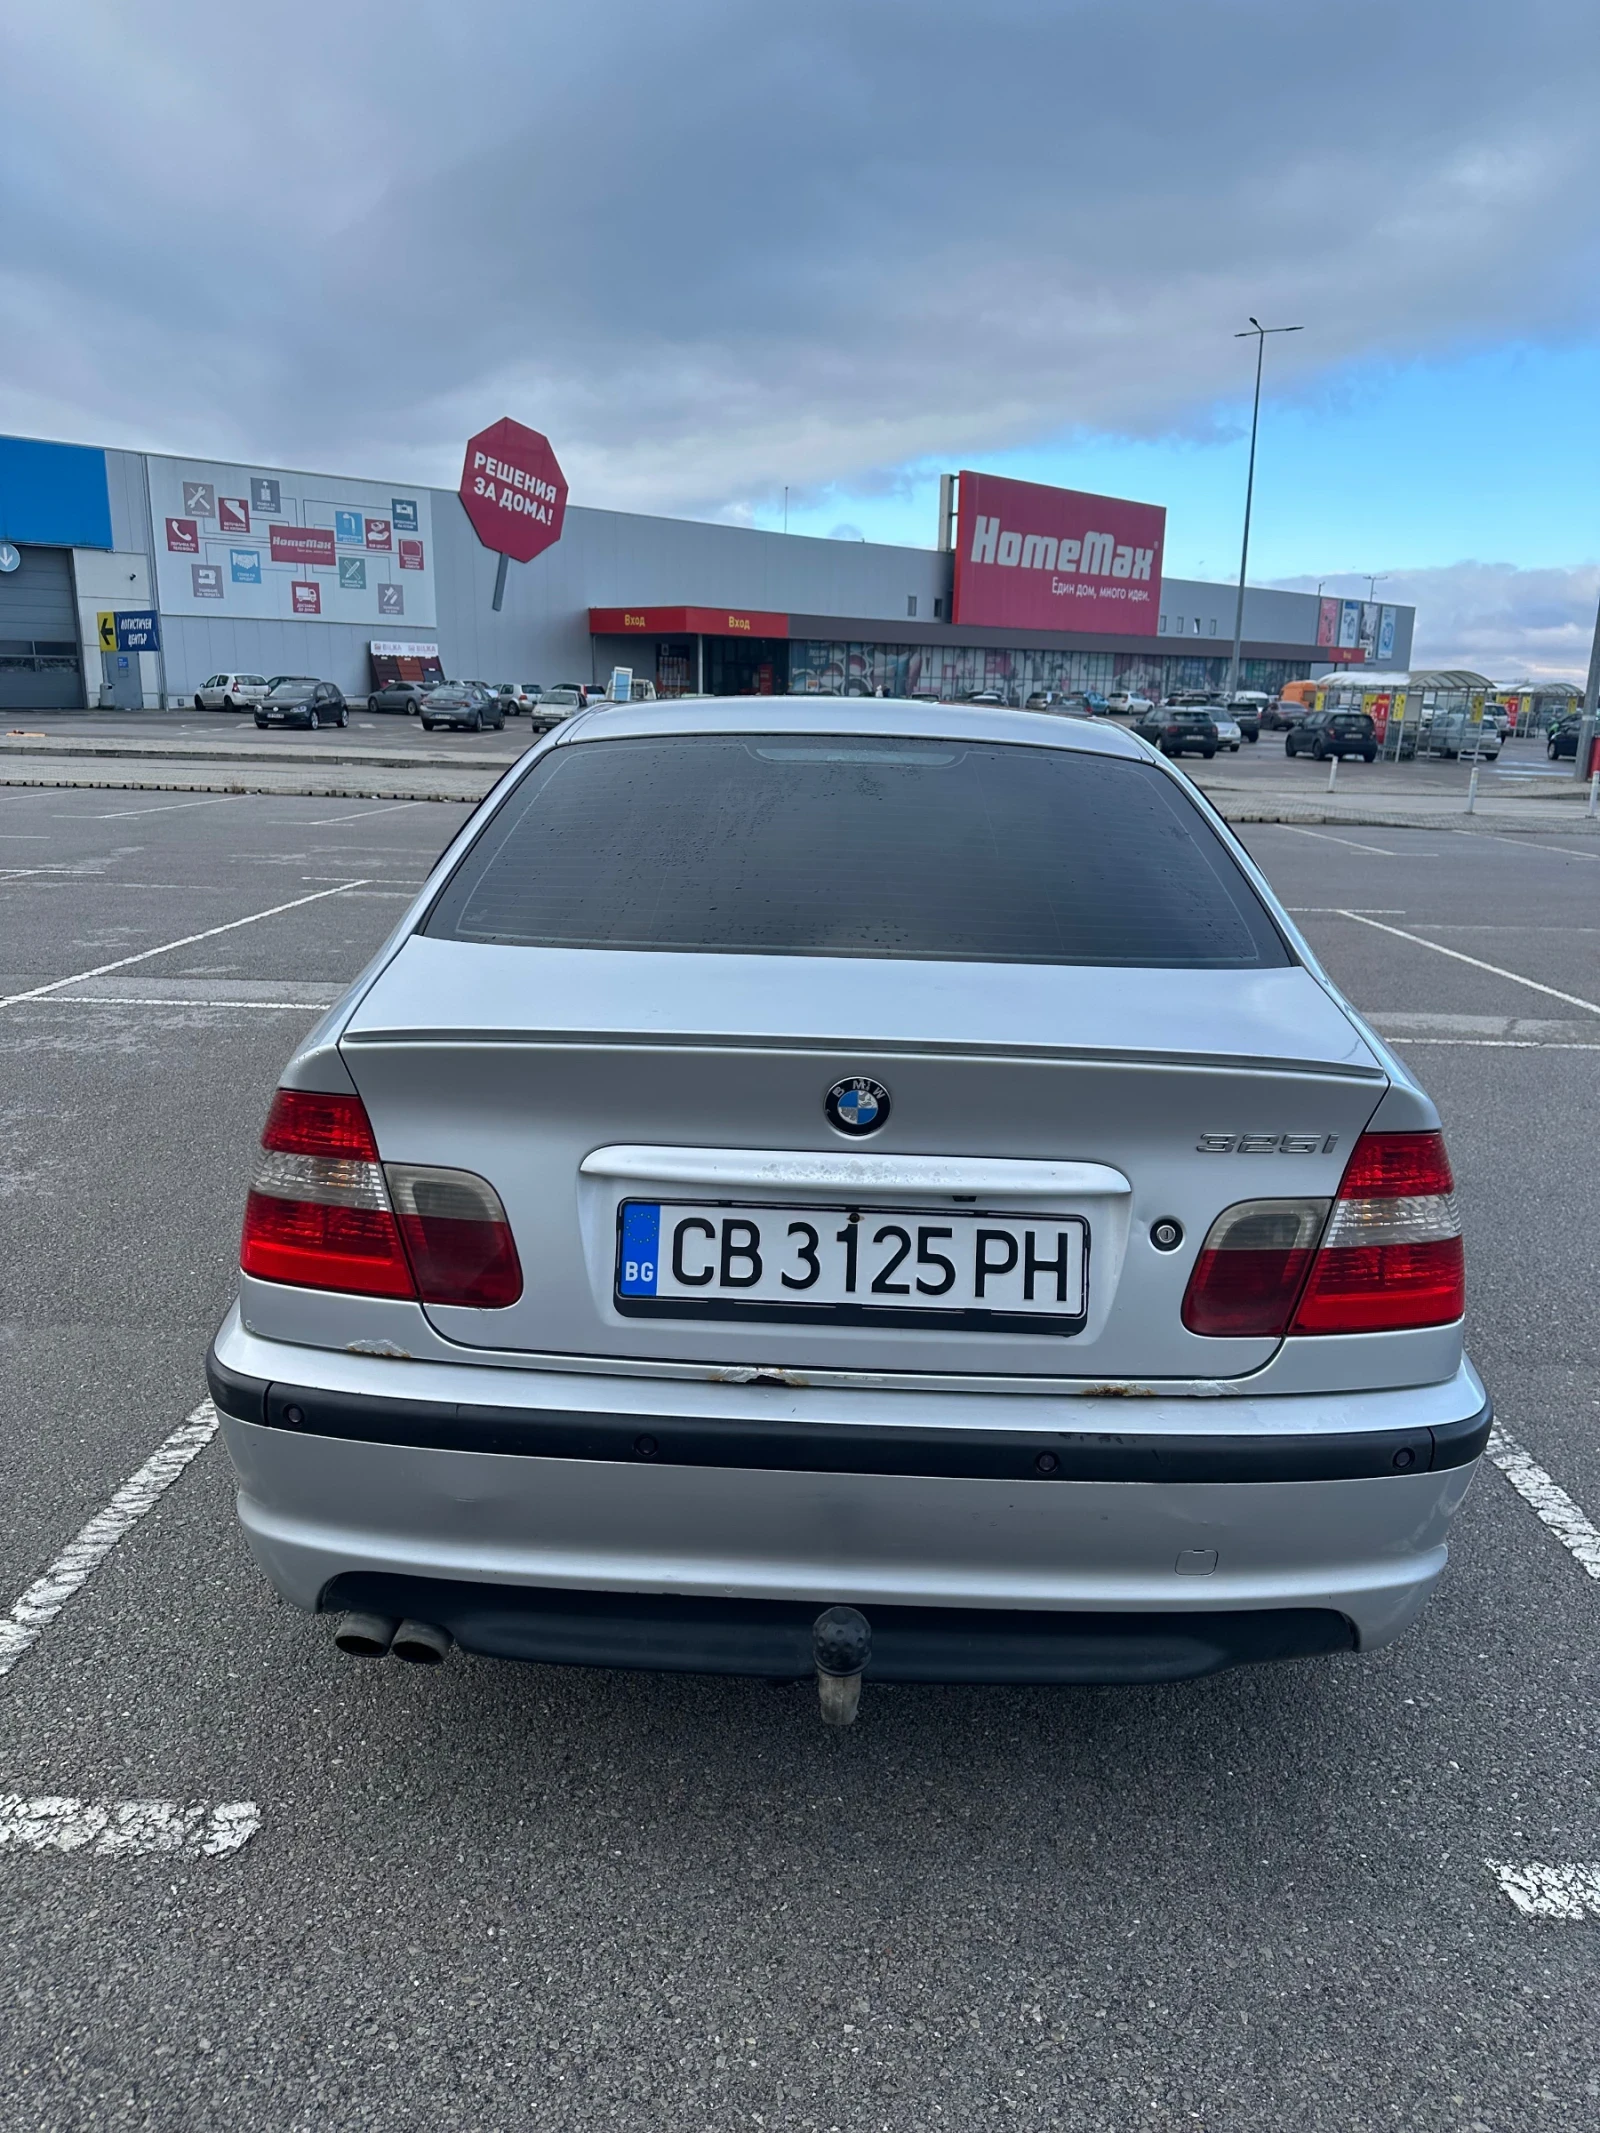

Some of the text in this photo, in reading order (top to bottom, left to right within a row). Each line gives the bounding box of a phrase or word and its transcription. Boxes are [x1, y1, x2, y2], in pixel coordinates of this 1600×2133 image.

[474, 451, 557, 504] РЕШЕНИЯ
[474, 477, 553, 526] ЗА ДОМА!
[272, 536, 332, 550] HomeMax
[970, 514, 1154, 581] HomeMax
[1052, 576, 1150, 603] Един дом, много идеи.
[624, 613, 646, 628] Вход
[728, 615, 751, 631] Вход
[382, 643, 402, 651] BILKA
[1196, 1132, 1340, 1154] 325i
[781, 1221, 956, 1297] 3125
[624, 1260, 655, 1283] BG
